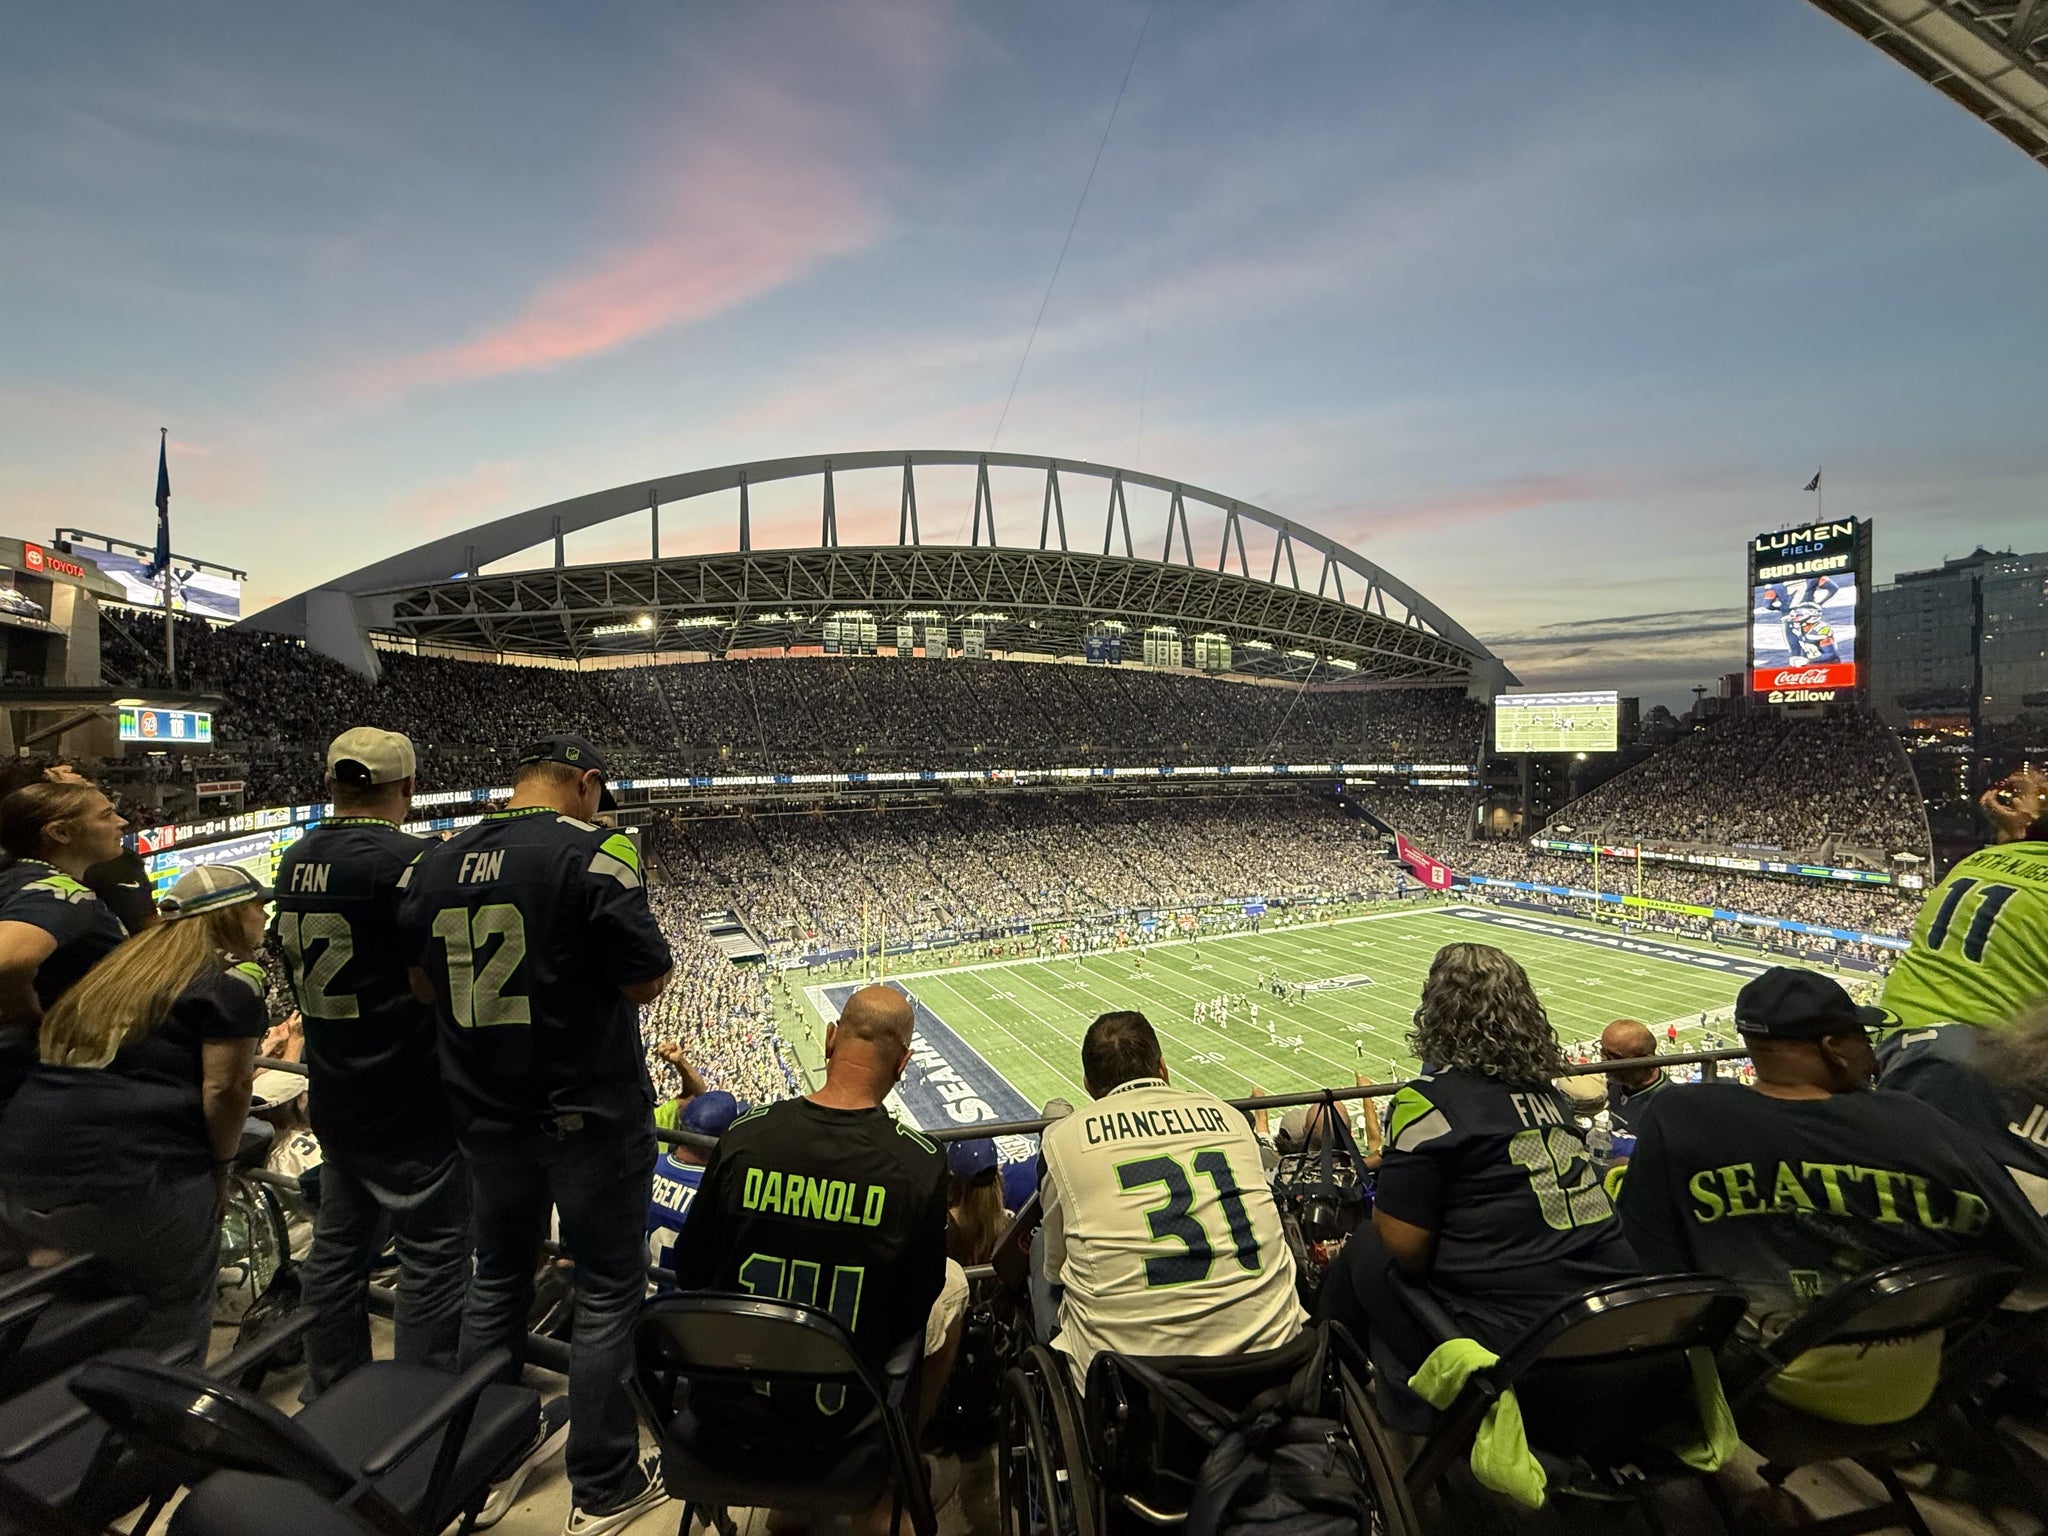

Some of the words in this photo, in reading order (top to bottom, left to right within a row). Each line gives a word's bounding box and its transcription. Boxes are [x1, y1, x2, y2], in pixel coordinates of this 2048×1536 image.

[1755, 521, 1853, 551] LUMEN
[1781, 542, 1824, 557] FIELD
[46, 556, 85, 578] TOYOTA
[1759, 563, 1797, 580] BUD
[1796, 554, 1849, 574] LIGHT
[1784, 690, 1835, 703] Zillow
[670, 778, 690, 786] BALL
[712, 776, 756, 785] SEAHAWKS
[757, 775, 775, 784] BALL
[791, 774, 832, 783] SEAHAWKS
[833, 774, 849, 782] BALL
[905, 772, 921, 780] BALL
[410, 792, 454, 807] SEAHAWKS
[455, 791, 472, 802] BALL
[489, 788, 515, 799] SEAHA
[413, 821, 432, 833] BALL
[453, 815, 484, 827] SEAHA
[290, 863, 332, 893] FAN
[458, 849, 506, 884] FAN
[1647, 901, 1687, 911] SEAHAWKS
[1655, 925, 1707, 940] SEAAWKS
[1927, 877, 2019, 965] 11
[1497, 918, 1731, 967] SEAHAWKS
[278, 912, 359, 1020] 12
[432, 903, 531, 1028] 12
[911, 1031, 999, 1124] SEAHA
[1509, 1092, 1565, 1128] FAN
[1085, 1107, 1230, 1145] CHANCELLOR
[1508, 1127, 1613, 1231] 12
[743, 1167, 887, 1227] DARNOLD
[1113, 1148, 1263, 1289] 31
